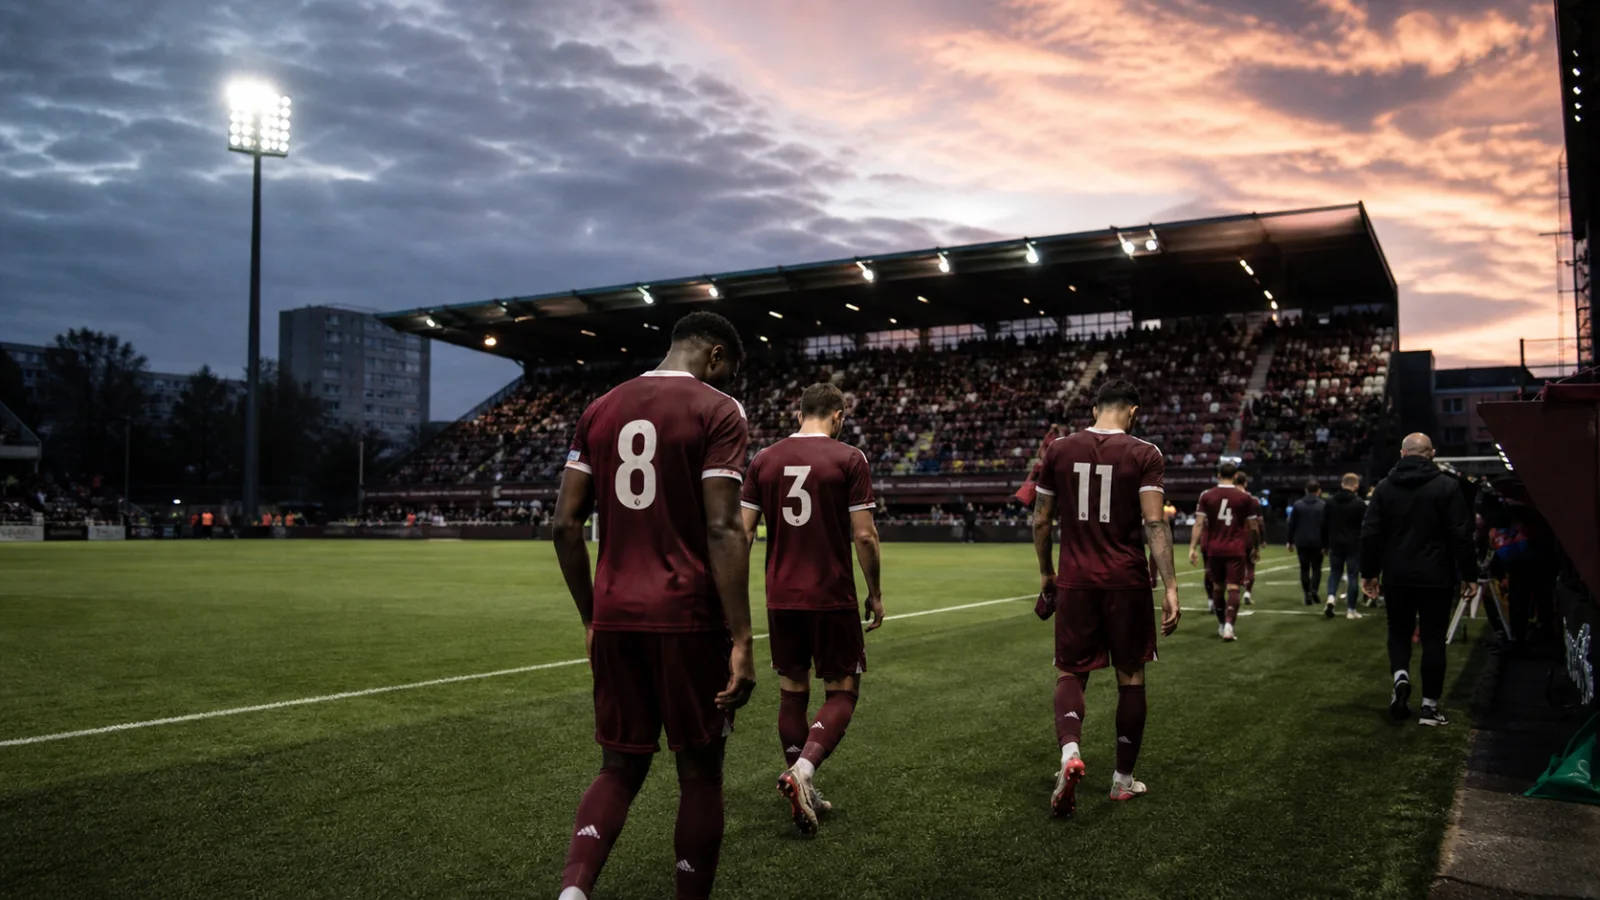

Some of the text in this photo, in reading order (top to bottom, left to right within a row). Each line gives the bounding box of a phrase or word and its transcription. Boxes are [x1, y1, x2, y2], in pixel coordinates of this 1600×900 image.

[615, 419, 657, 510] 8
[1073, 462, 1113, 523] 11
[782, 465, 812, 527] 3
[1217, 498, 1233, 526] 4
